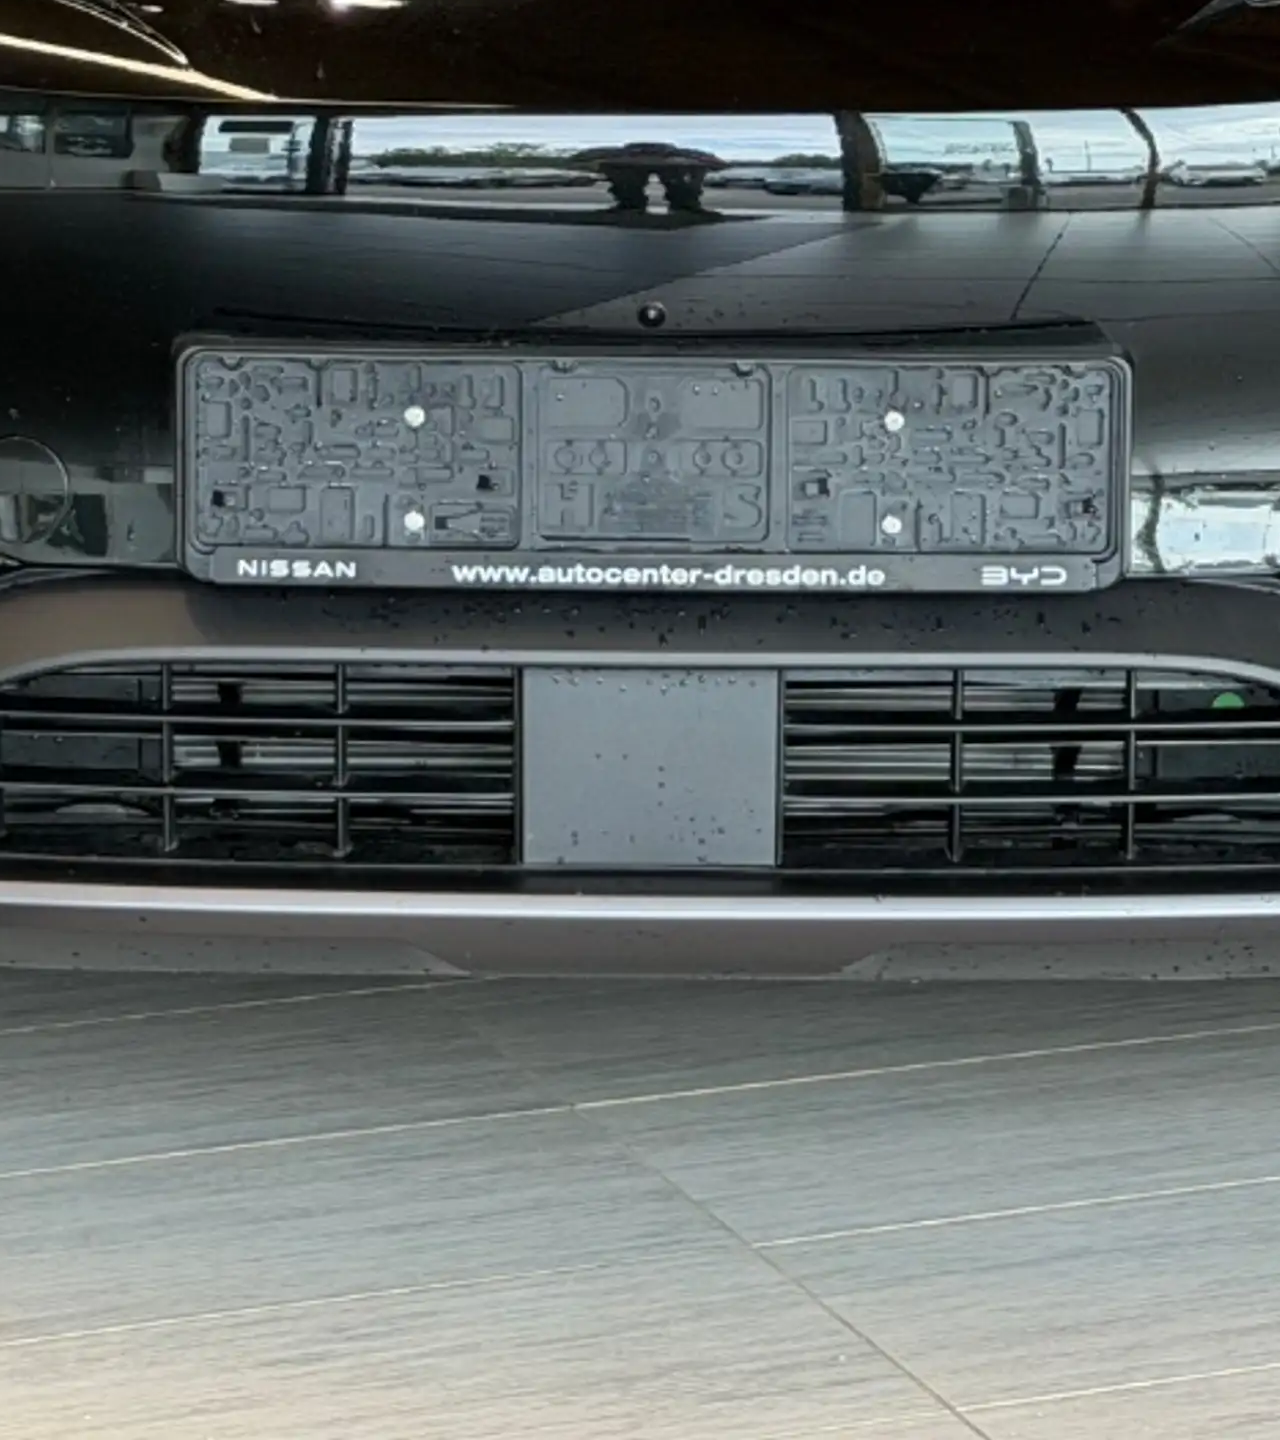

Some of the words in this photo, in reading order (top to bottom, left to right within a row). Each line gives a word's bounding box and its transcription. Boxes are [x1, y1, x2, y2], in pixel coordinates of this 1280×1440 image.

[236, 558, 357, 579] NISSAN
[450, 562, 887, 588] www.autocenter-dresden.de
[980, 564, 1068, 587] BYD
